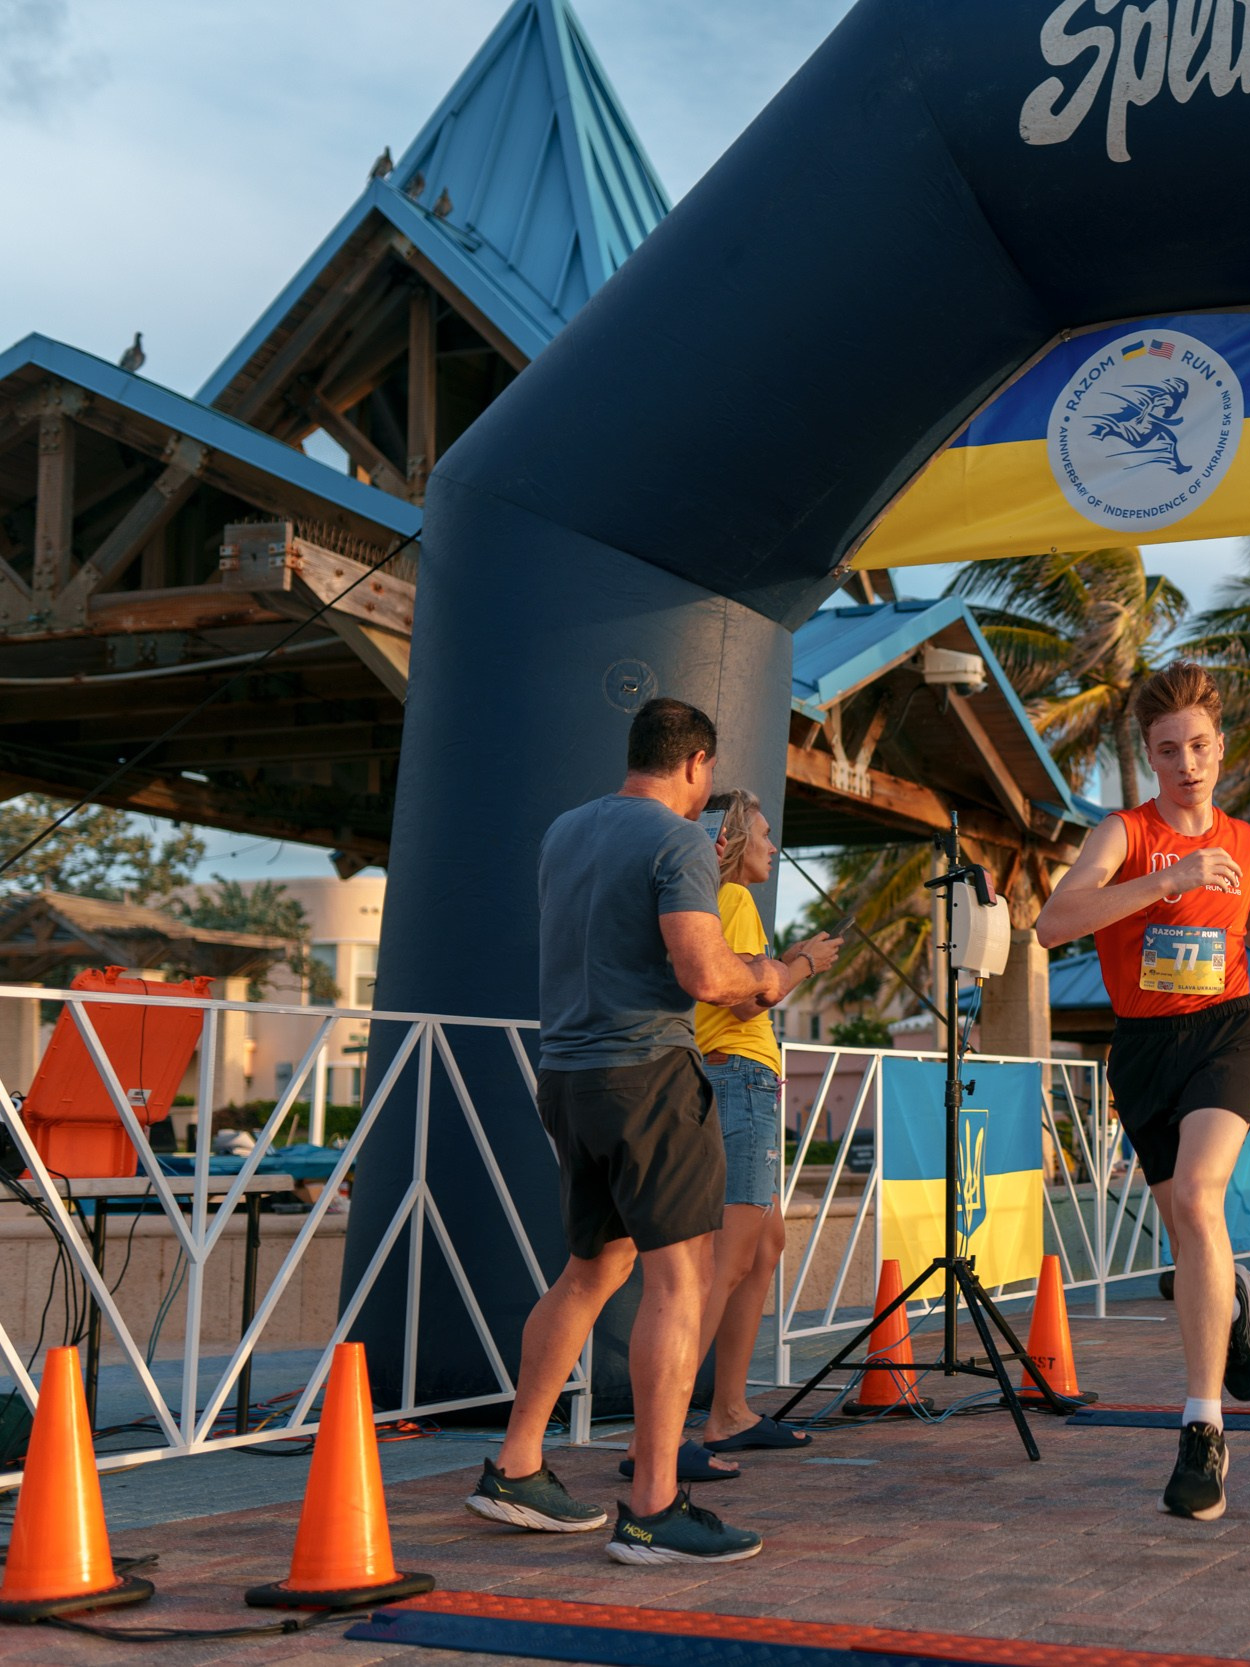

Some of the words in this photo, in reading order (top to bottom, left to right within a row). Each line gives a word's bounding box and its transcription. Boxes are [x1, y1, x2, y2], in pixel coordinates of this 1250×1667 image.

[1066, 356, 1115, 411] RAZOM
[1181, 350, 1216, 381] RUN
[1221, 390, 1232, 411] RUN
[1222, 412, 1232, 426] 5K
[1059, 426, 1089, 497] ANNIVERSARY
[1202, 430, 1229, 478] UKRAINE
[1188, 478, 1202, 495] OF
[1087, 495, 1103, 507] OF
[1103, 493, 1188, 518] INDEPENDENCE
[1205, 884, 1223, 892] RUN
[1152, 927, 1184, 937] RAZOM
[1201, 930, 1219, 939] RUN
[1172, 943, 1199, 971] 77
[622, 1522, 653, 1544] HOKA
